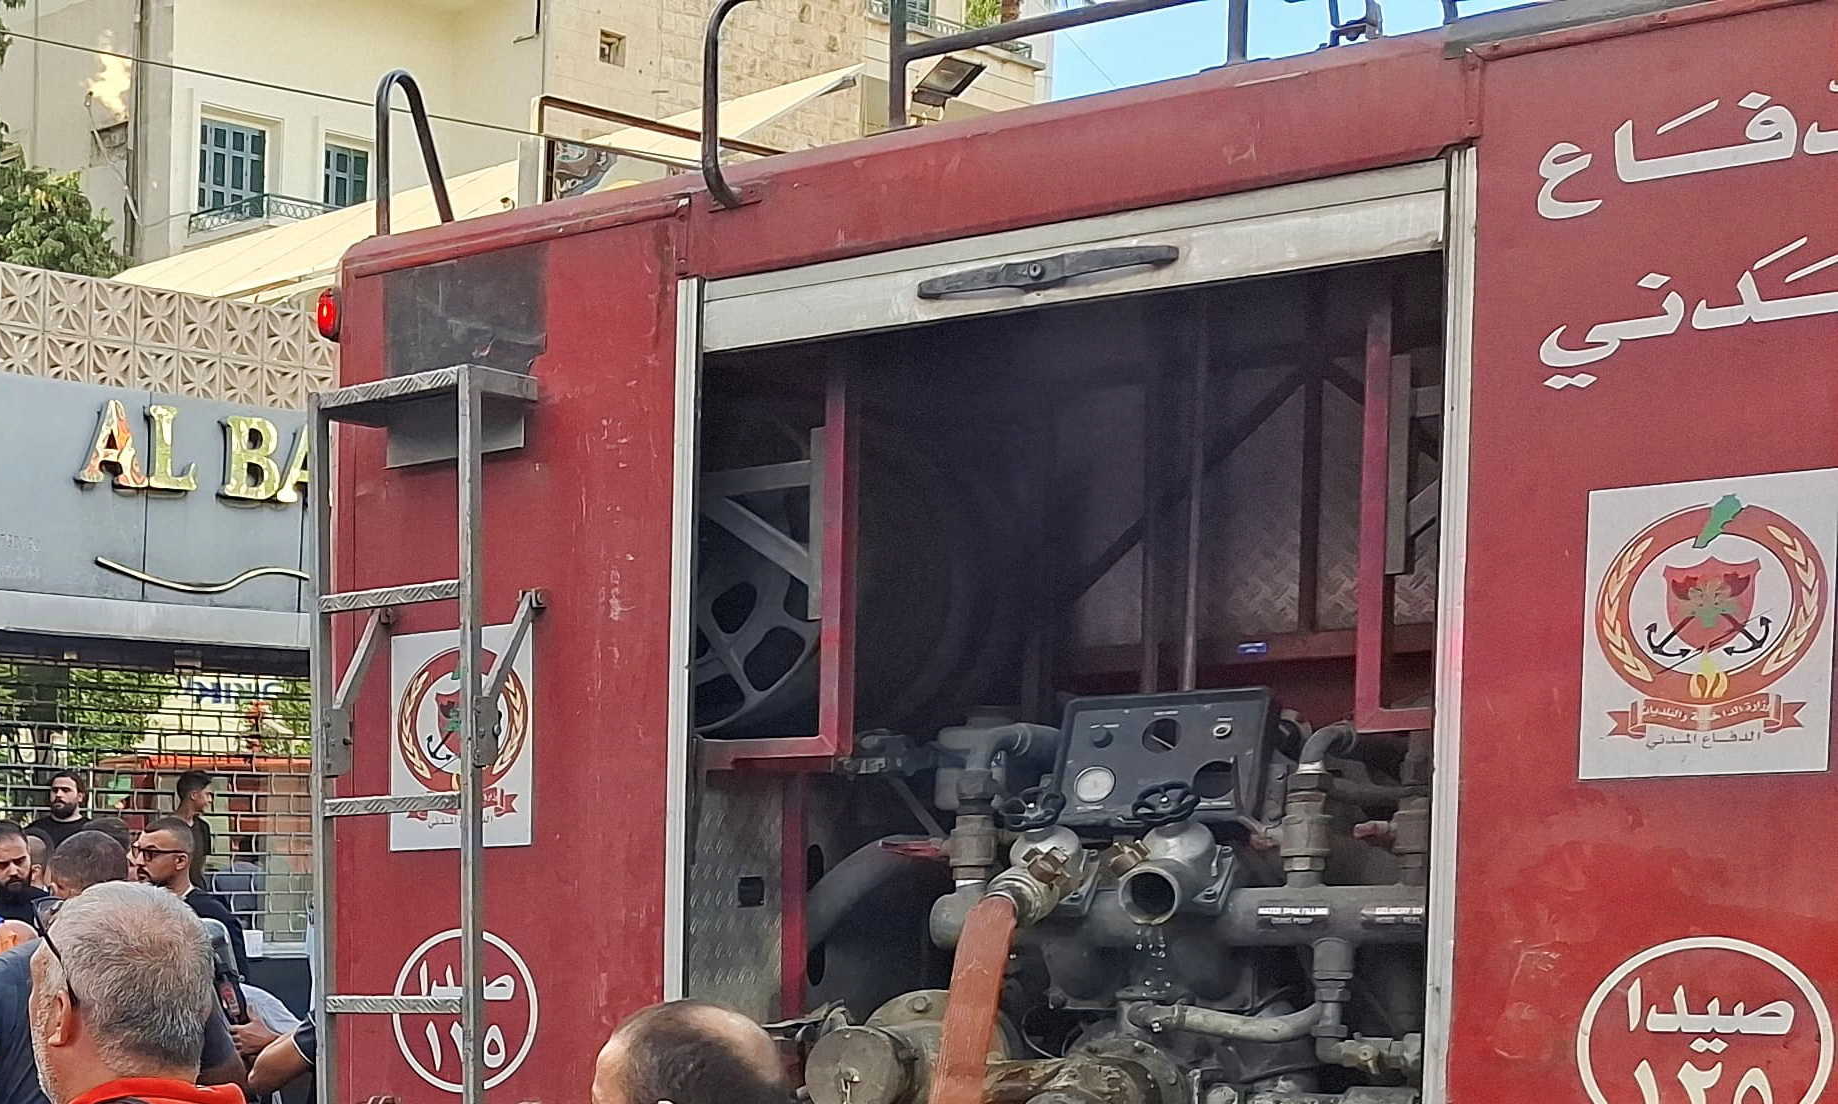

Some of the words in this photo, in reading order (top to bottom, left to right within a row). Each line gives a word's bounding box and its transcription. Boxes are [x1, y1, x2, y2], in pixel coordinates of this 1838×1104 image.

[73, 399, 198, 493] AL
[1645, 732, 1697, 750] المدني
[1701, 730, 1761, 749] الدفاع
[1626, 976, 1796, 1055] صيدا
